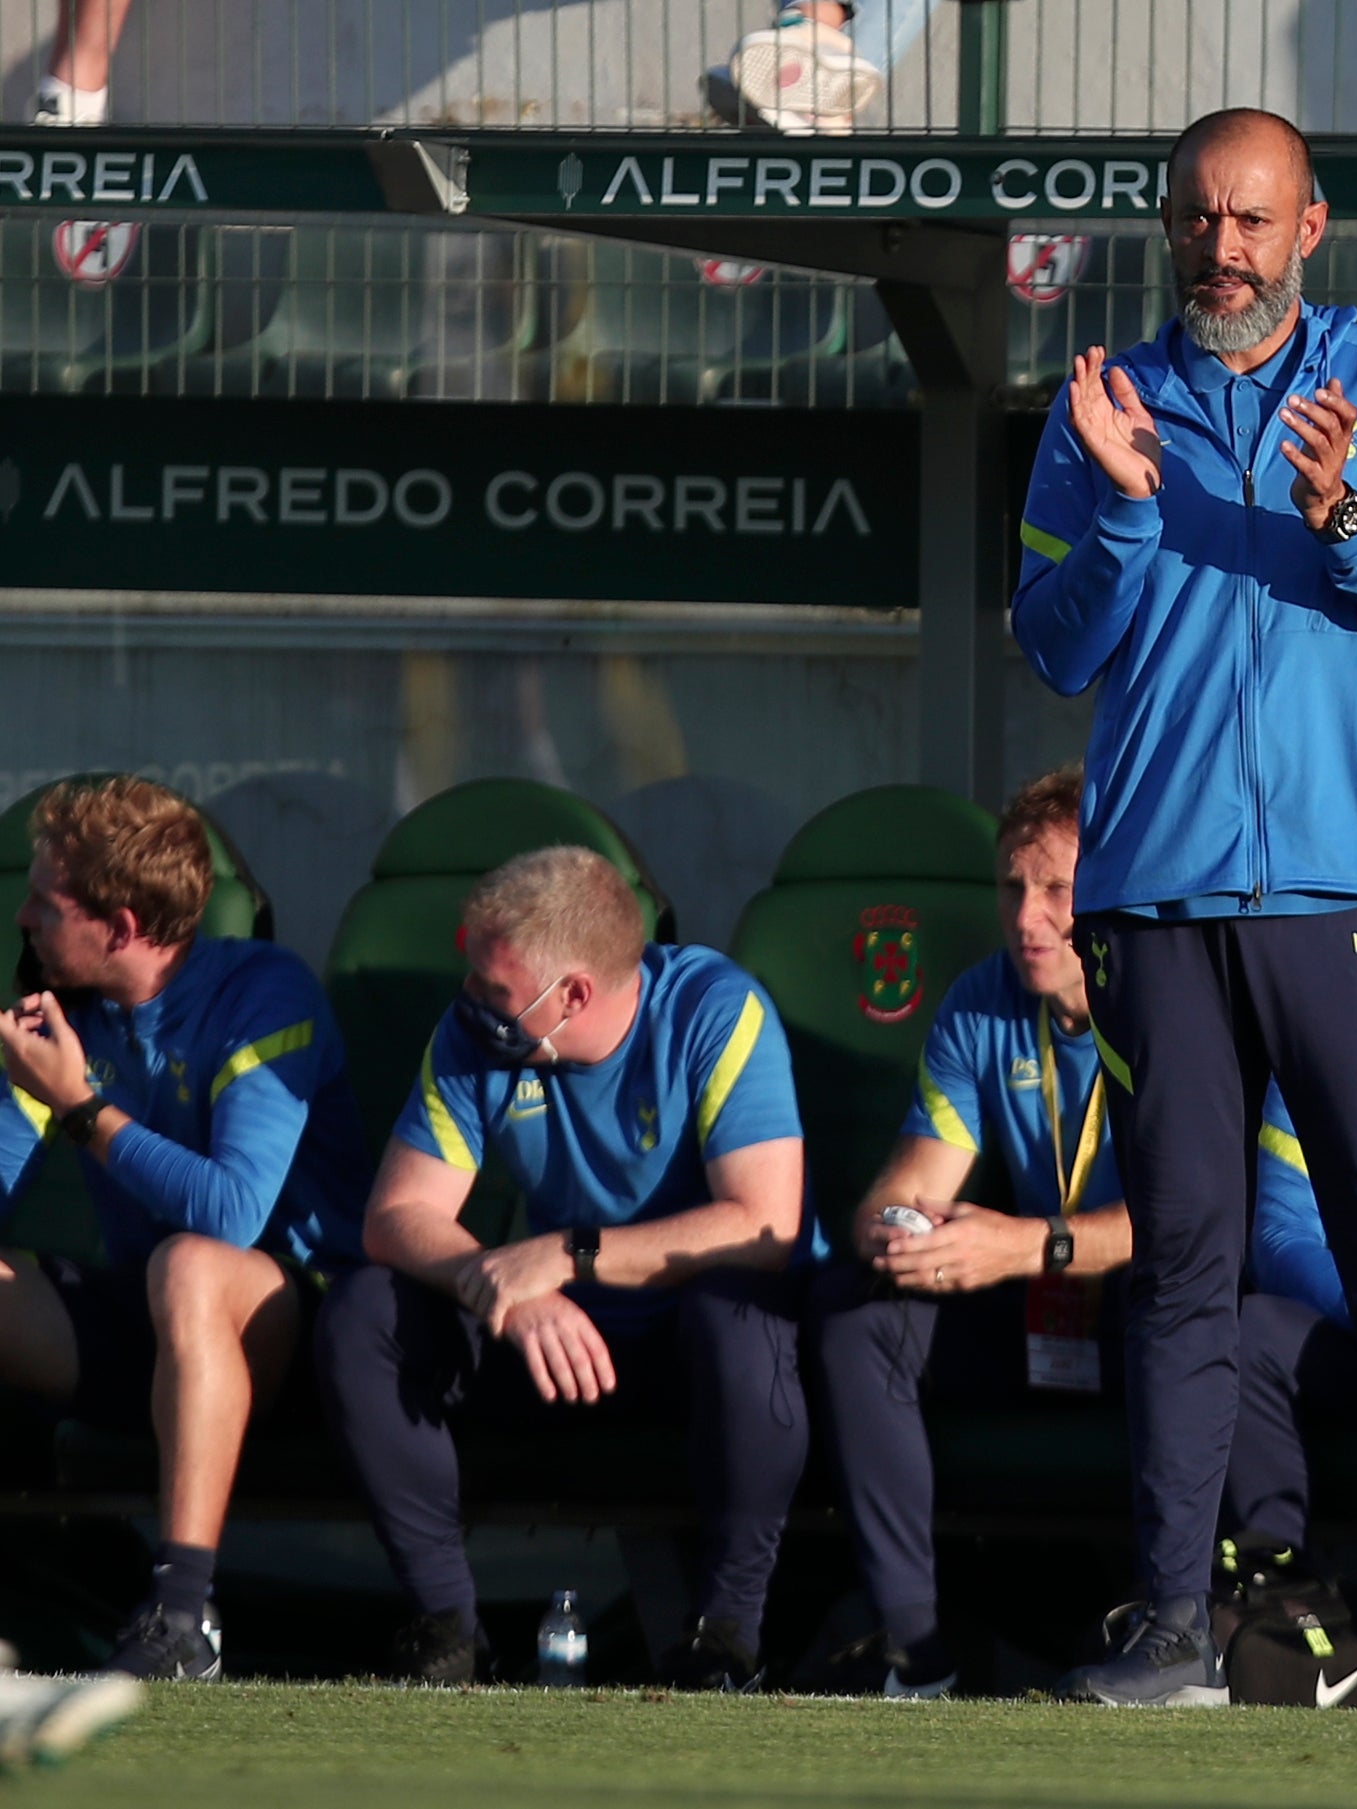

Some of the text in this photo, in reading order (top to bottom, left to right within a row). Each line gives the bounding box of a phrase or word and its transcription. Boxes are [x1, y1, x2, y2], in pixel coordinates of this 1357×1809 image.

[601, 157, 962, 209] ALFREDO
[43, 463, 871, 535] ALFREDO CORREIA
